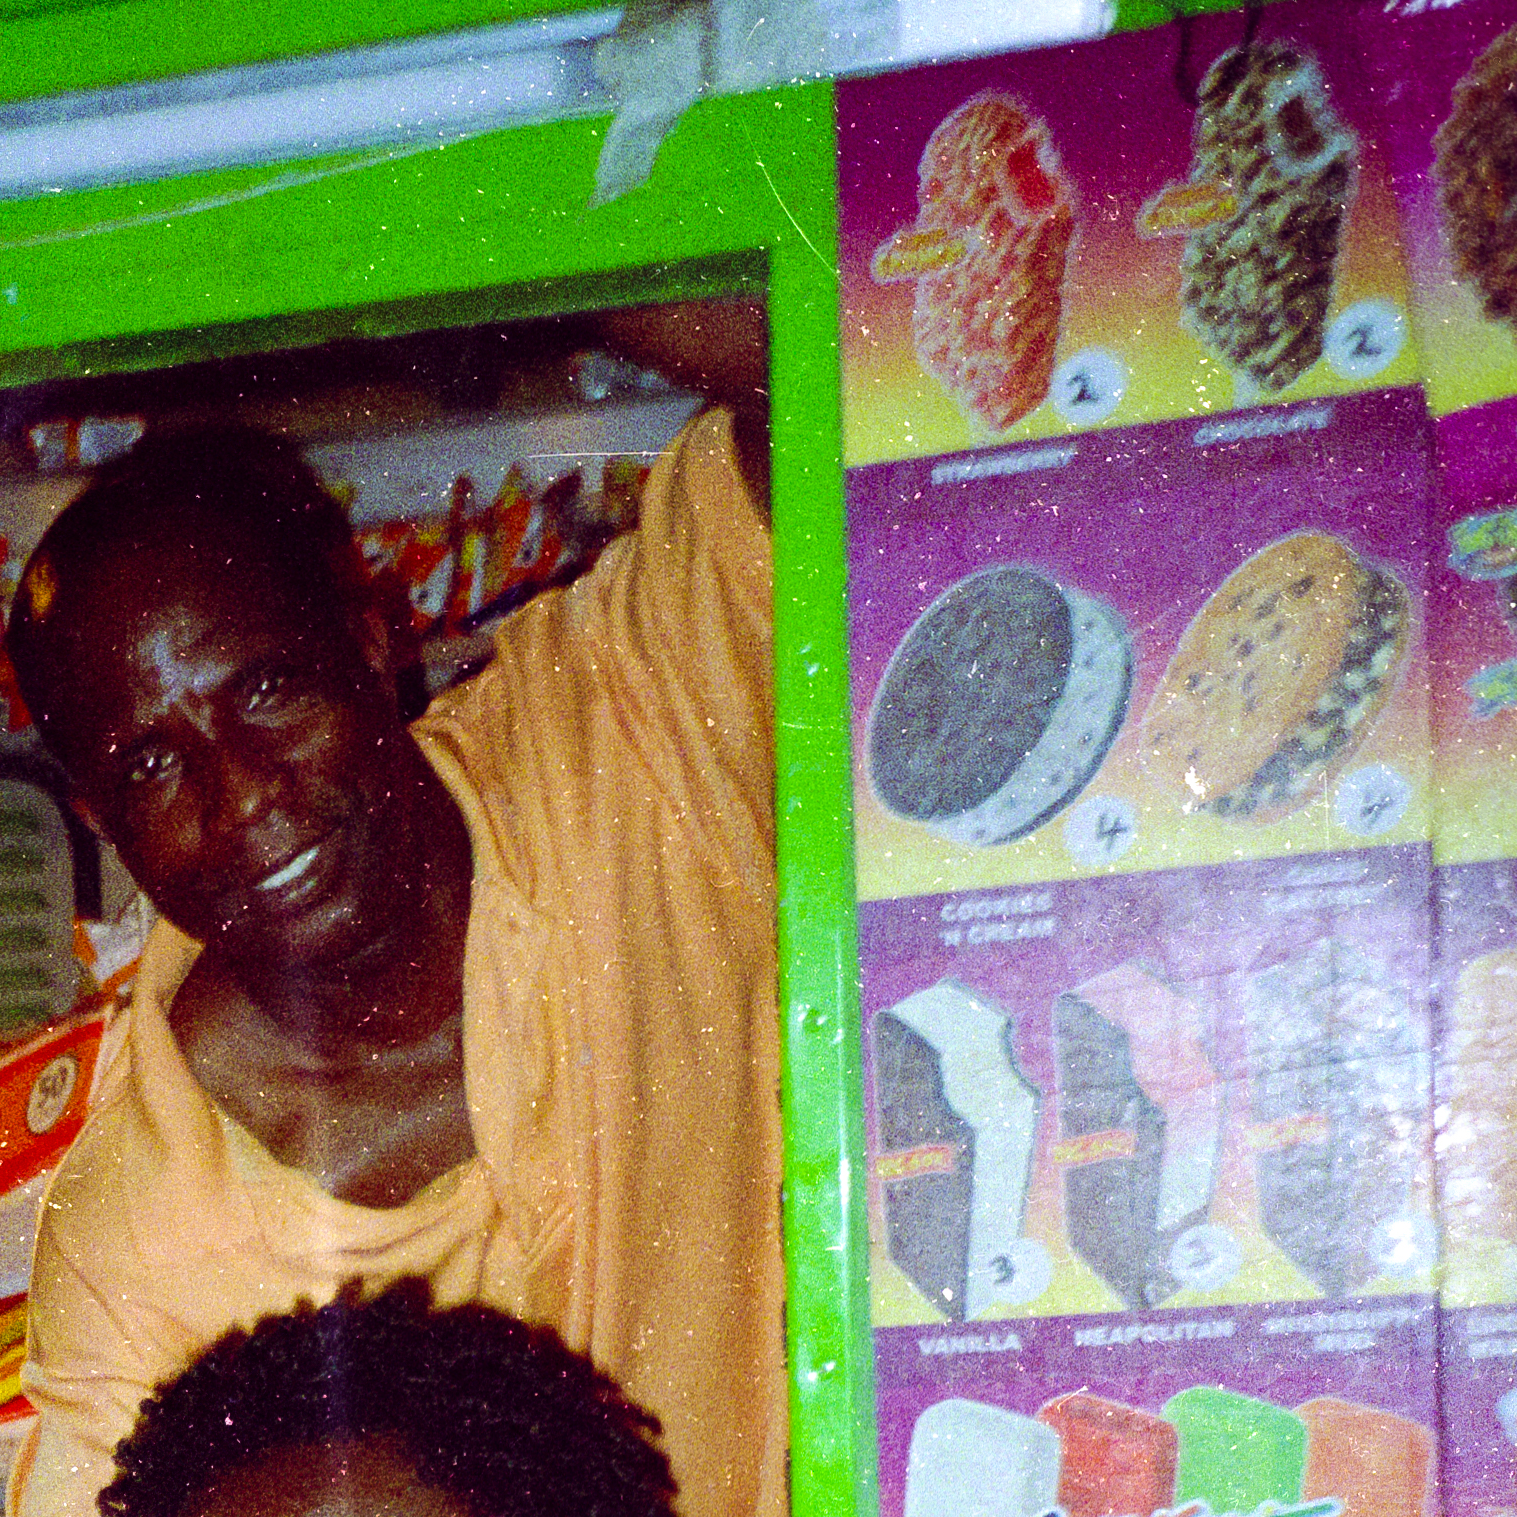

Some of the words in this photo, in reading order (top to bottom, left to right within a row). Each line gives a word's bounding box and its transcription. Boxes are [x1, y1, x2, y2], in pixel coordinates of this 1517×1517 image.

[1096, 811, 1130, 851] 4
[919, 1334, 1022, 1355] VANILLA
[1074, 1320, 1236, 1346] NEAPOLITAN
